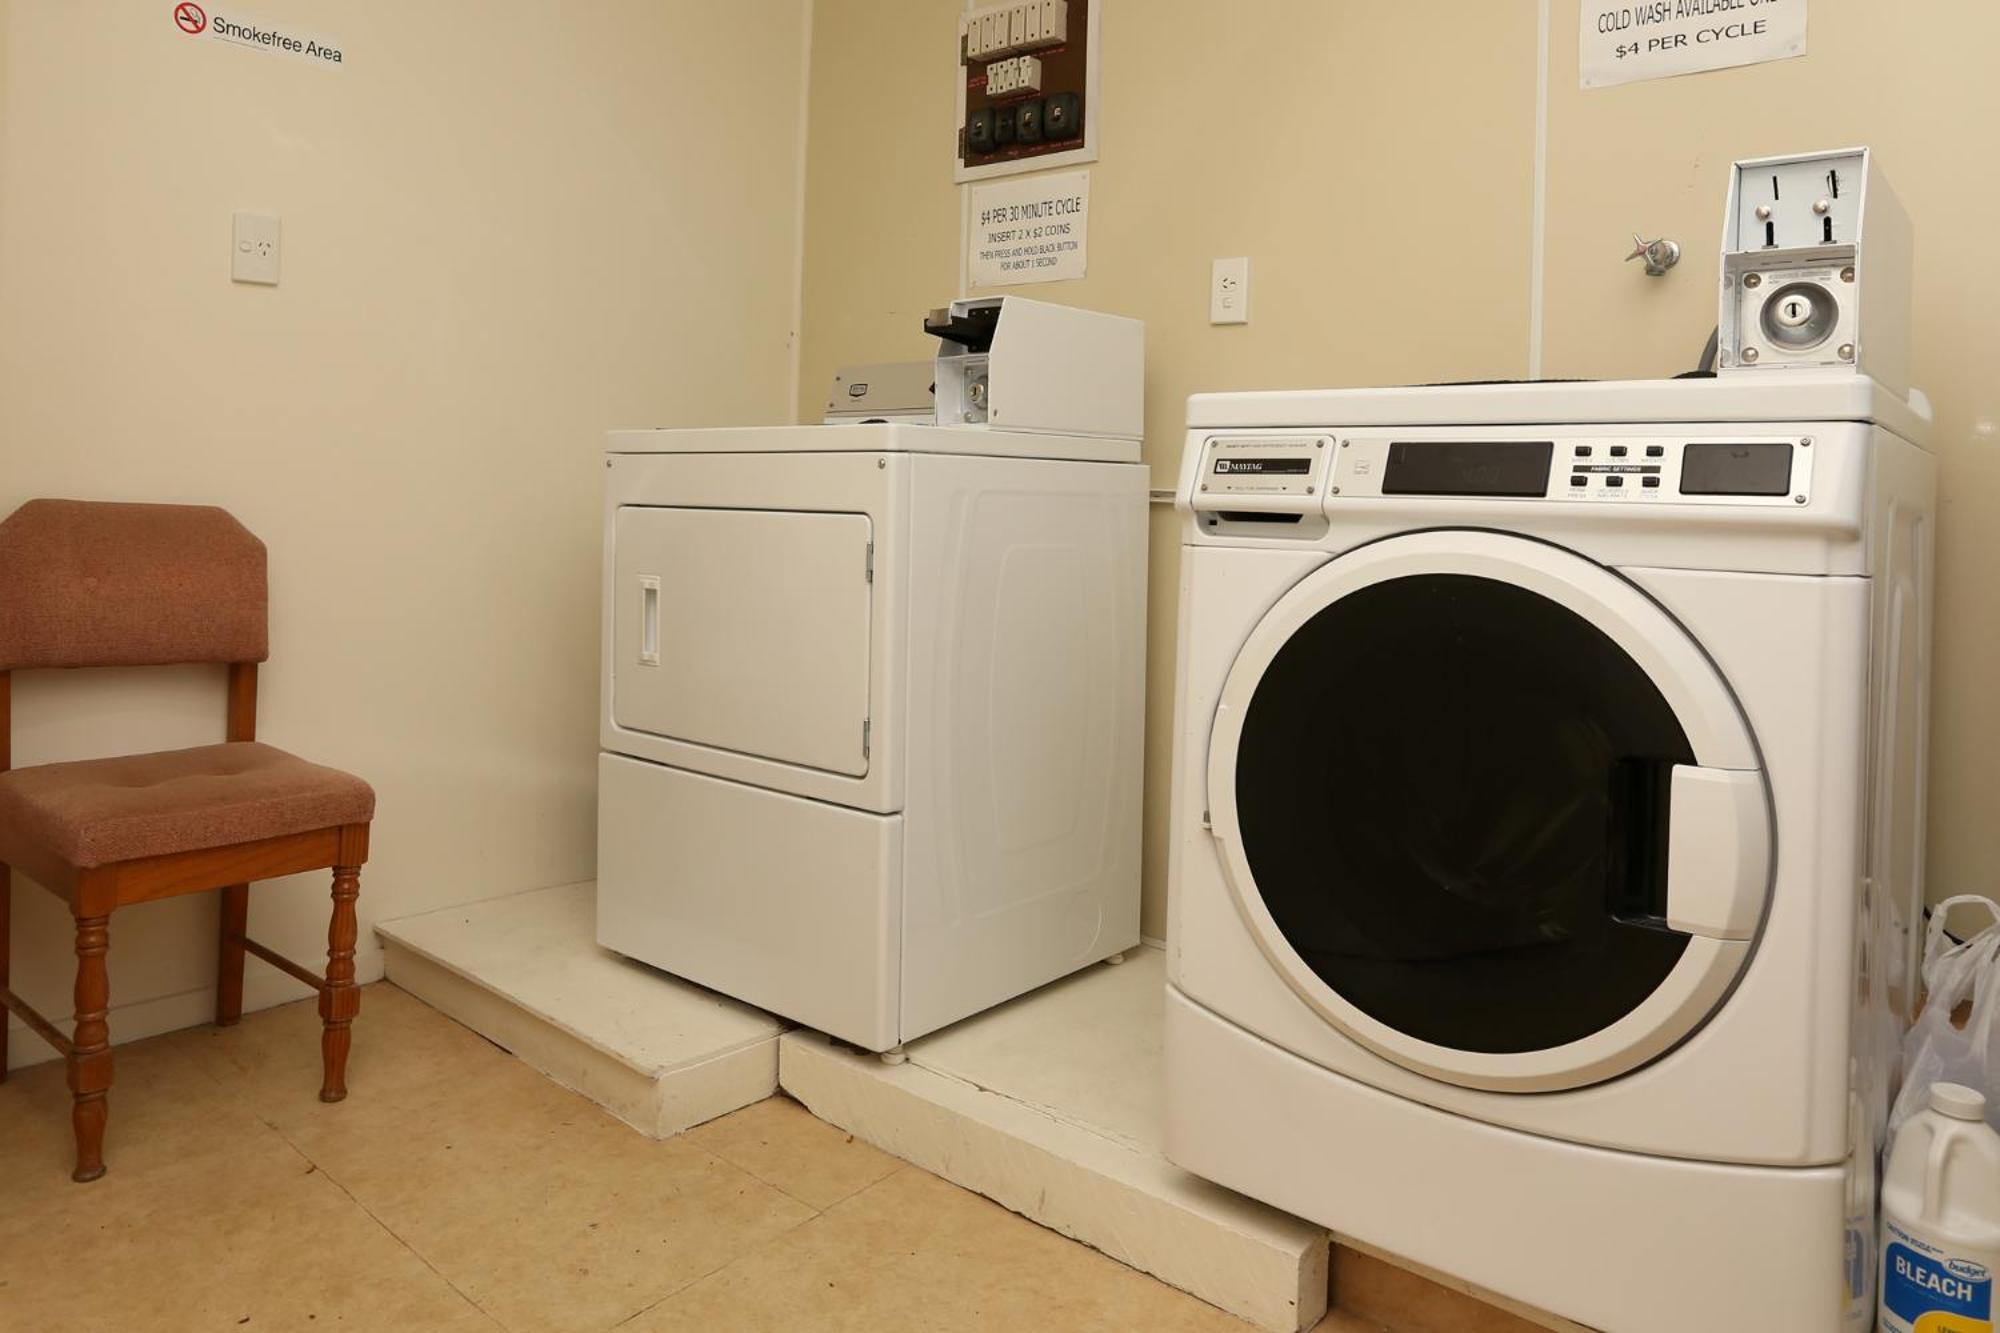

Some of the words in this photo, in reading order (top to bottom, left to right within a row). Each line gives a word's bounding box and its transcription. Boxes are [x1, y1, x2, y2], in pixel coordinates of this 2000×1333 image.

[1598, 9, 1631, 33] COLD
[1634, 1, 1672, 26] WASH
[213, 16, 302, 52] Smokefree
[305, 41, 342, 63] Area
[1615, 43, 1639, 59] $4
[1648, 33, 1688, 52] PER
[1696, 20, 1767, 44] CYCLE
[981, 210, 991, 226] $4
[993, 208, 1008, 224] PER
[1009, 206, 1020, 222] 30
[1021, 201, 1054, 220] MINUTE
[1056, 197, 1082, 215] CYCLE
[988, 230, 1017, 243] INSERT
[1018, 229, 1024, 240] 2
[1033, 226, 1043, 238] $2
[1045, 223, 1071, 236] COINS
[1895, 1255, 1973, 1302] BLEACH
